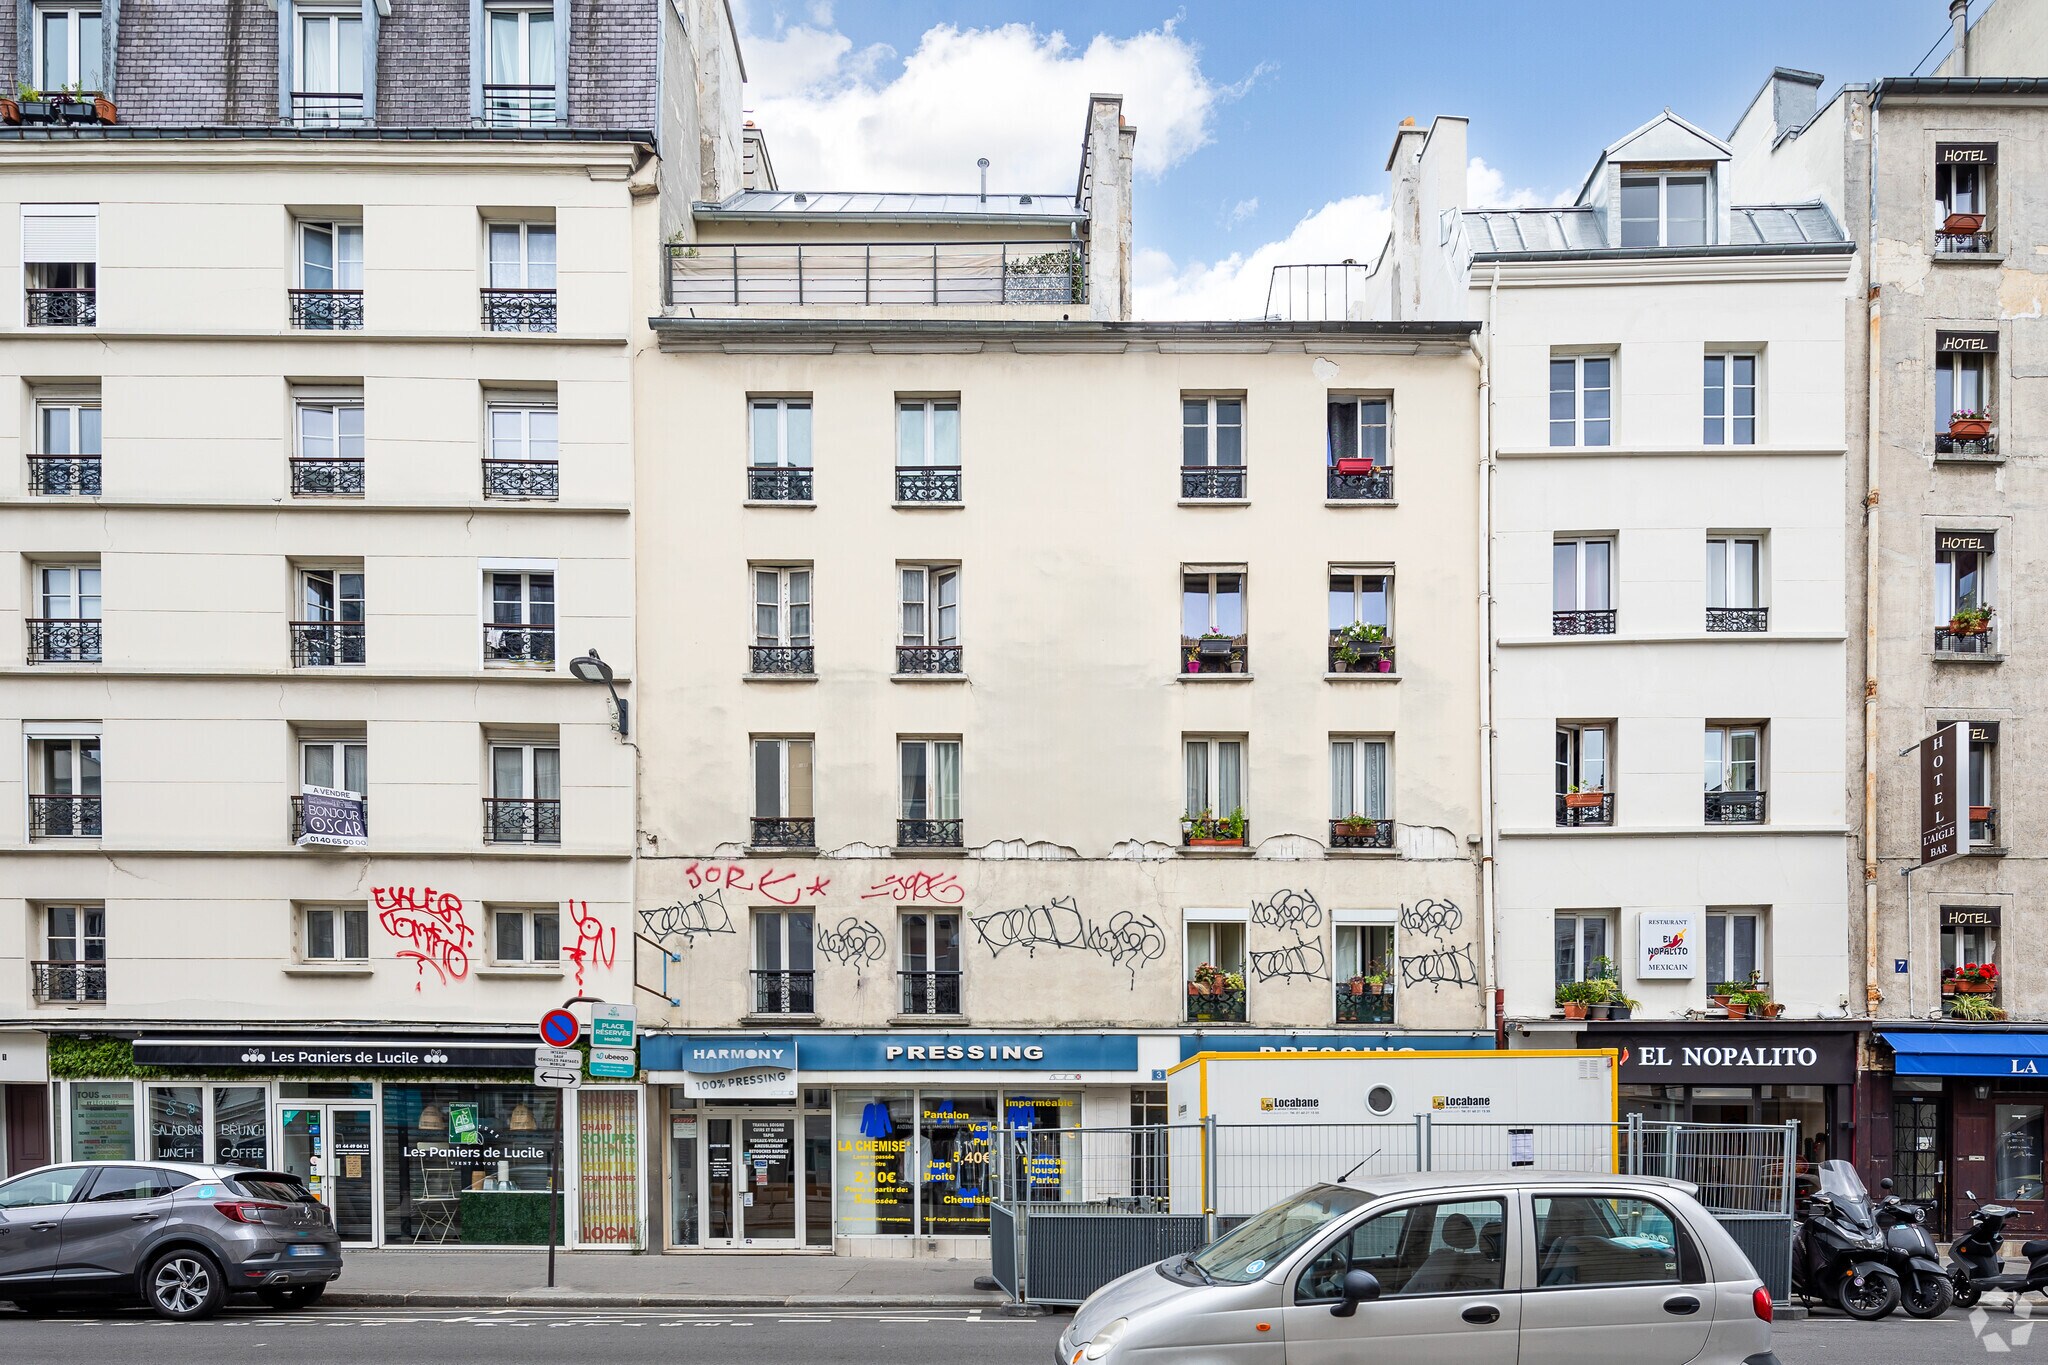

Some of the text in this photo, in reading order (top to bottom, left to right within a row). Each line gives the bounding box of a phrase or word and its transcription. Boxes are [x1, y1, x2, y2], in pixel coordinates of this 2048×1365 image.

[1944, 148, 1988, 162] HOTEL
[1944, 336, 1988, 350] HOTEL
[1942, 536, 1985, 549] HOTEL
[1934, 735, 1944, 824] HOTEL
[320, 788, 350, 798] VENDRE
[308, 804, 359, 820] BONJOUR
[310, 816, 362, 836] OSCAR
[1924, 826, 1955, 846] L'AIGLE
[1930, 844, 1948, 858] BAR
[1949, 912, 1992, 924] HOTEL
[596, 1028, 631, 1037] RÉSERVÉE
[272, 1051, 418, 1064] Les Paniers de Lucile
[693, 1050, 784, 1059] HARMONY
[886, 1046, 1044, 1060] PRESSING
[1638, 1047, 1817, 1066] EL NOPALITO
[2011, 1060, 2038, 1073] LA
[696, 1072, 786, 1090] 100% PRESSING
[1006, 1099, 1073, 1108] Imperméable
[1274, 1098, 1319, 1107] Locabane
[1446, 1096, 1490, 1106] Locabane
[924, 1111, 969, 1119] Pantalon
[221, 1124, 265, 1136] BRUNCH
[582, 1134, 636, 1144] SOUPES
[838, 1140, 852, 1151] LA
[159, 1148, 194, 1158] LUNCH
[221, 1147, 264, 1159] COFFEE
[404, 1147, 544, 1158] Les Paniers de Lucile
[927, 1160, 952, 1170] Jupe
[924, 1172, 955, 1180] Droite
[944, 1196, 991, 1204] Chemisie
[584, 1226, 636, 1239] LOCAL
